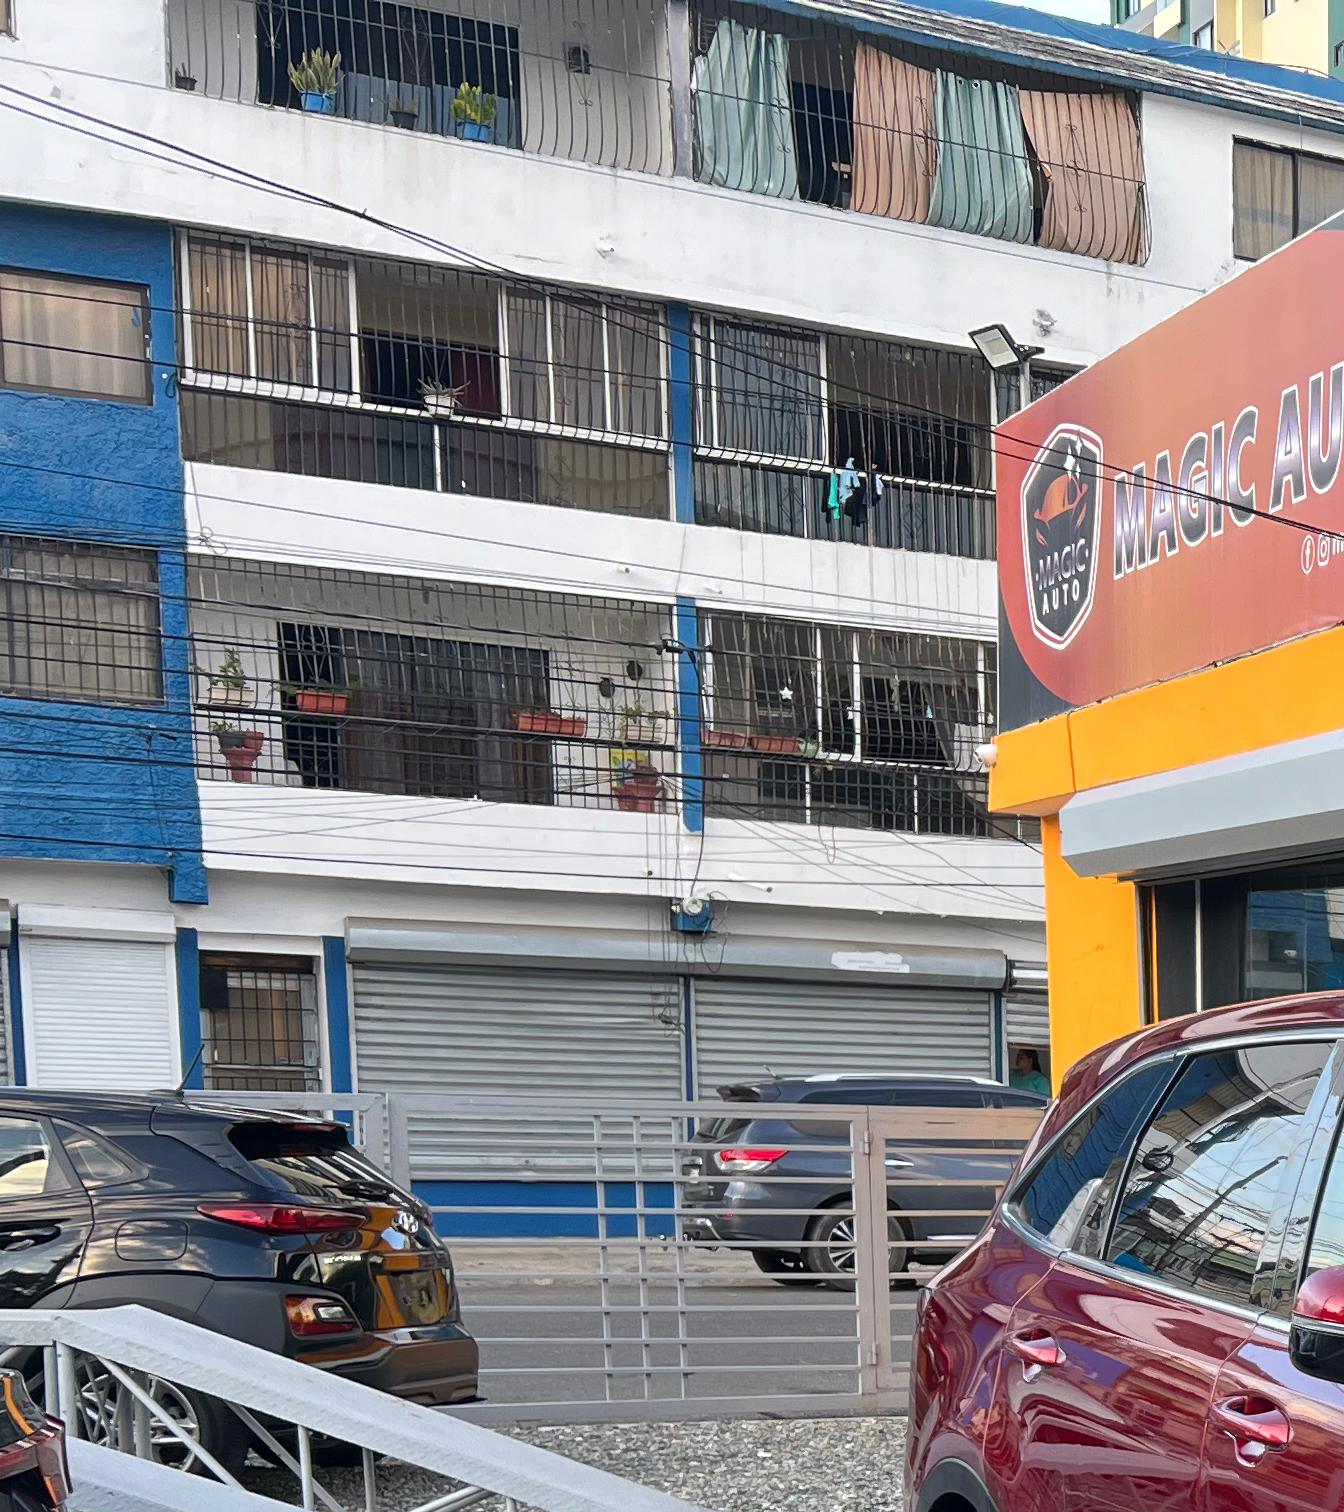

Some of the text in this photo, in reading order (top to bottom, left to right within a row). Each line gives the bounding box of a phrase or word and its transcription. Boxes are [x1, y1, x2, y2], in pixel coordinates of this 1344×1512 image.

[1113, 405, 1258, 580] MAGIC
[1038, 538, 1086, 591] MAGIC
[1042, 578, 1080, 616] AUTO
